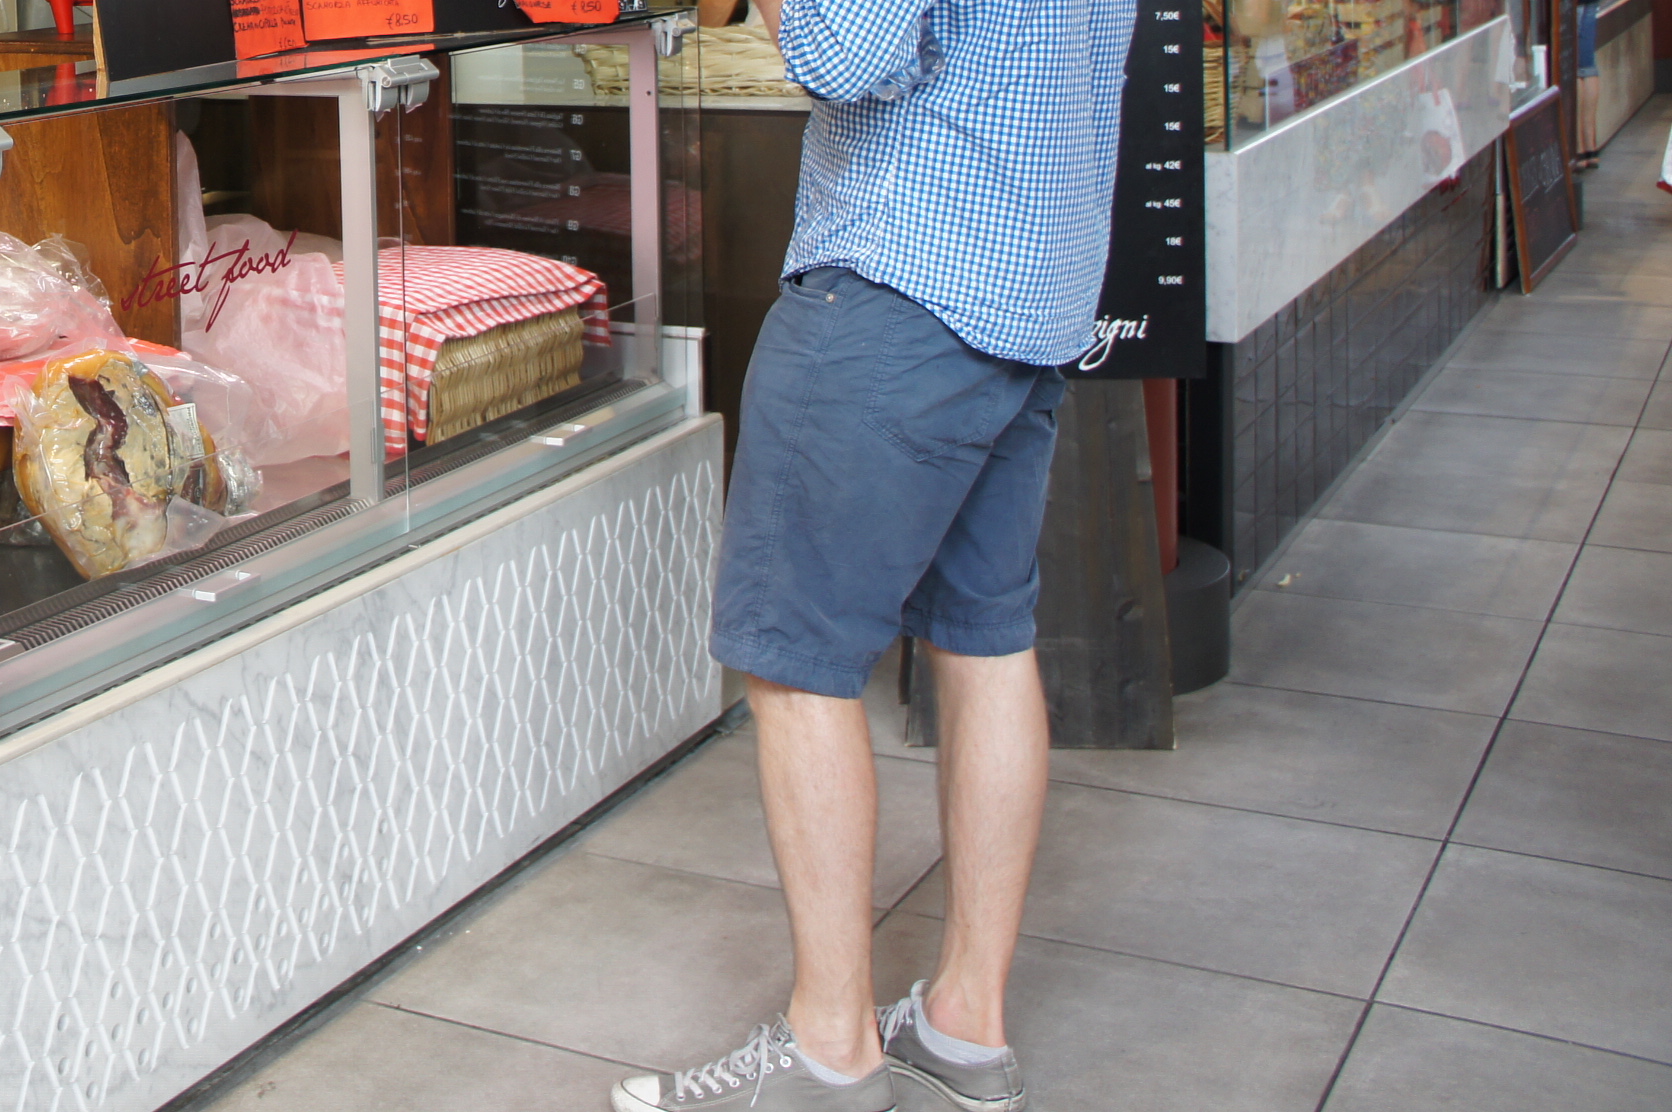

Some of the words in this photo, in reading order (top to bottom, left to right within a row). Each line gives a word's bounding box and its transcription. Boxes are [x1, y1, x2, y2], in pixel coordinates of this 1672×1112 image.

[1155, 11, 1179, 20] 7,50€
[121, 241, 223, 312] street
[206, 229, 298, 333] food
